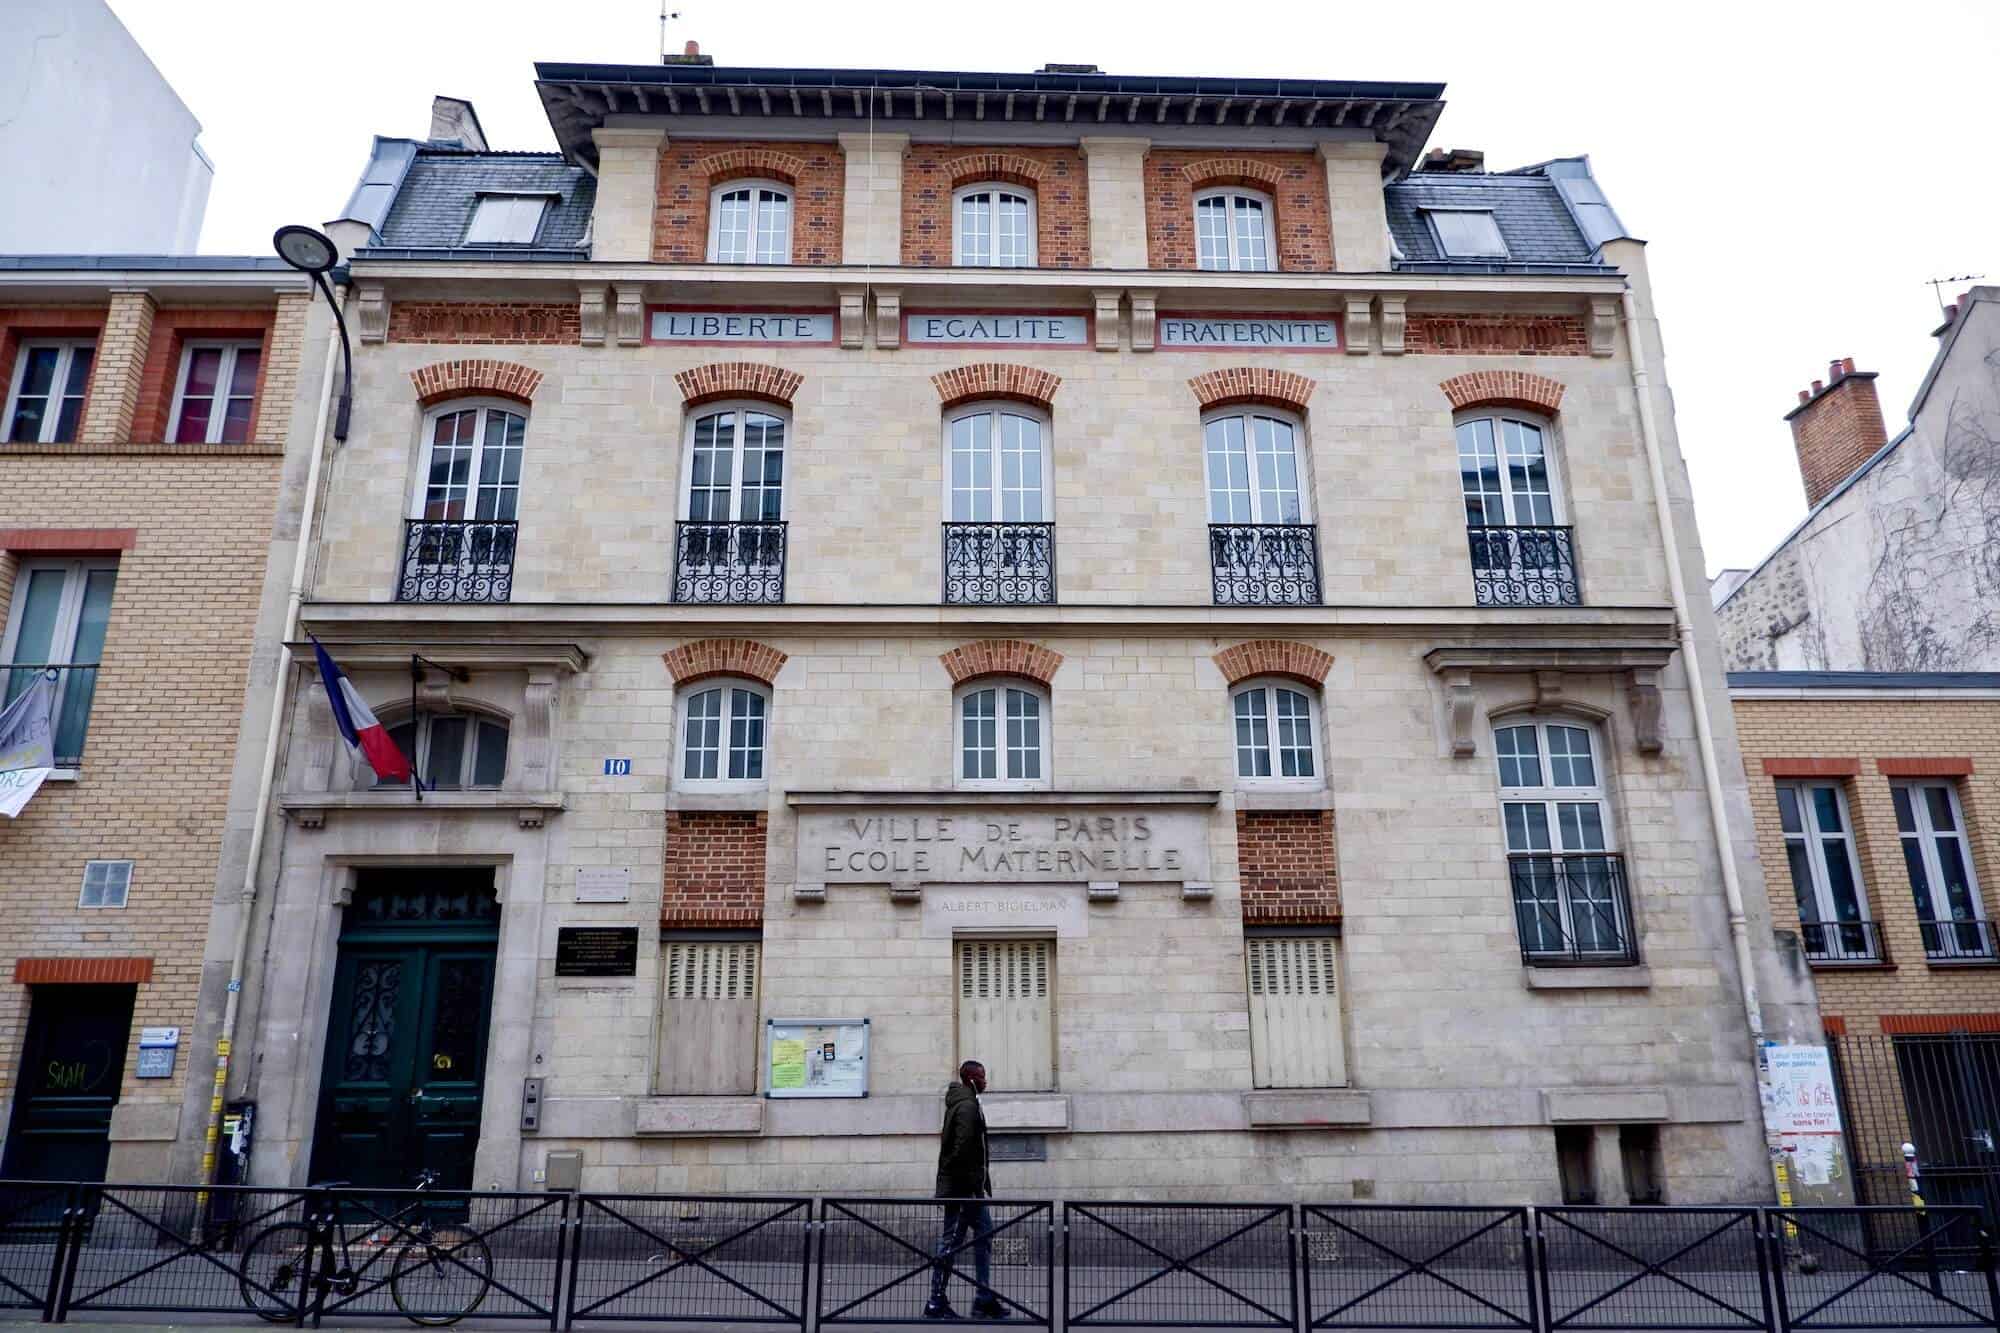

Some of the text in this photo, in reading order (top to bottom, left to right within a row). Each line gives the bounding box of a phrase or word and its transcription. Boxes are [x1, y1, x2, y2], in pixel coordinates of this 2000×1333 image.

[669, 316, 813, 339] LIBERTE
[926, 319, 1066, 339] EGALITE
[1166, 322, 1332, 344] FRATERNITE
[609, 759, 626, 775] 10
[848, 817, 1151, 842] VILLE DE PARIS
[824, 846, 1182, 873] ECOLE MATERNELLE
[942, 900, 992, 912] ALBERT
